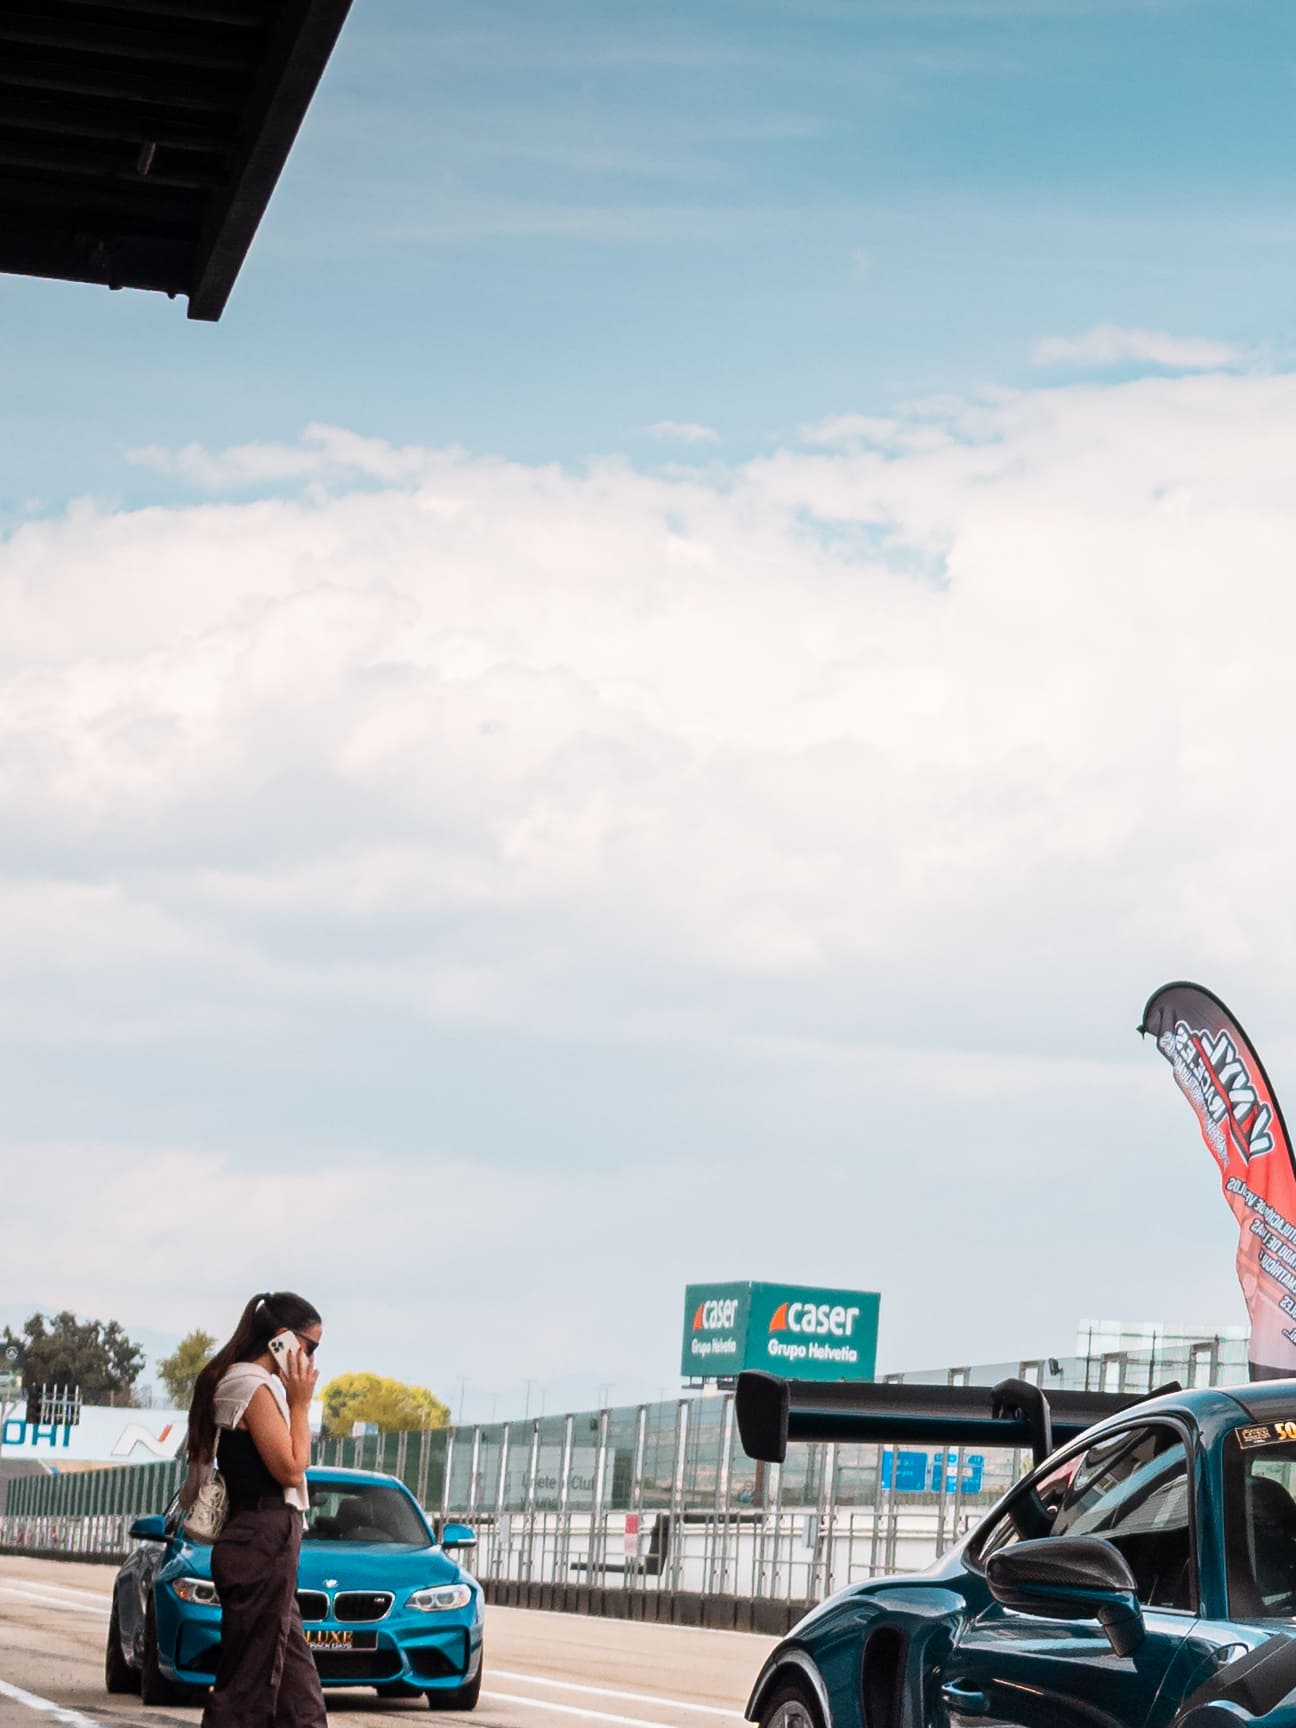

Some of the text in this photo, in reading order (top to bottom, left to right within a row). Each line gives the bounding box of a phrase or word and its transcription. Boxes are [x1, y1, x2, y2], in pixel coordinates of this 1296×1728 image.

[702, 1299, 738, 1329] caser
[788, 1302, 859, 1335] caser
[691, 1337, 737, 1357] Grupo Helvetia
[768, 1338, 857, 1362] Grupo Helvetia
[304, 1630, 353, 1643] LUXE
